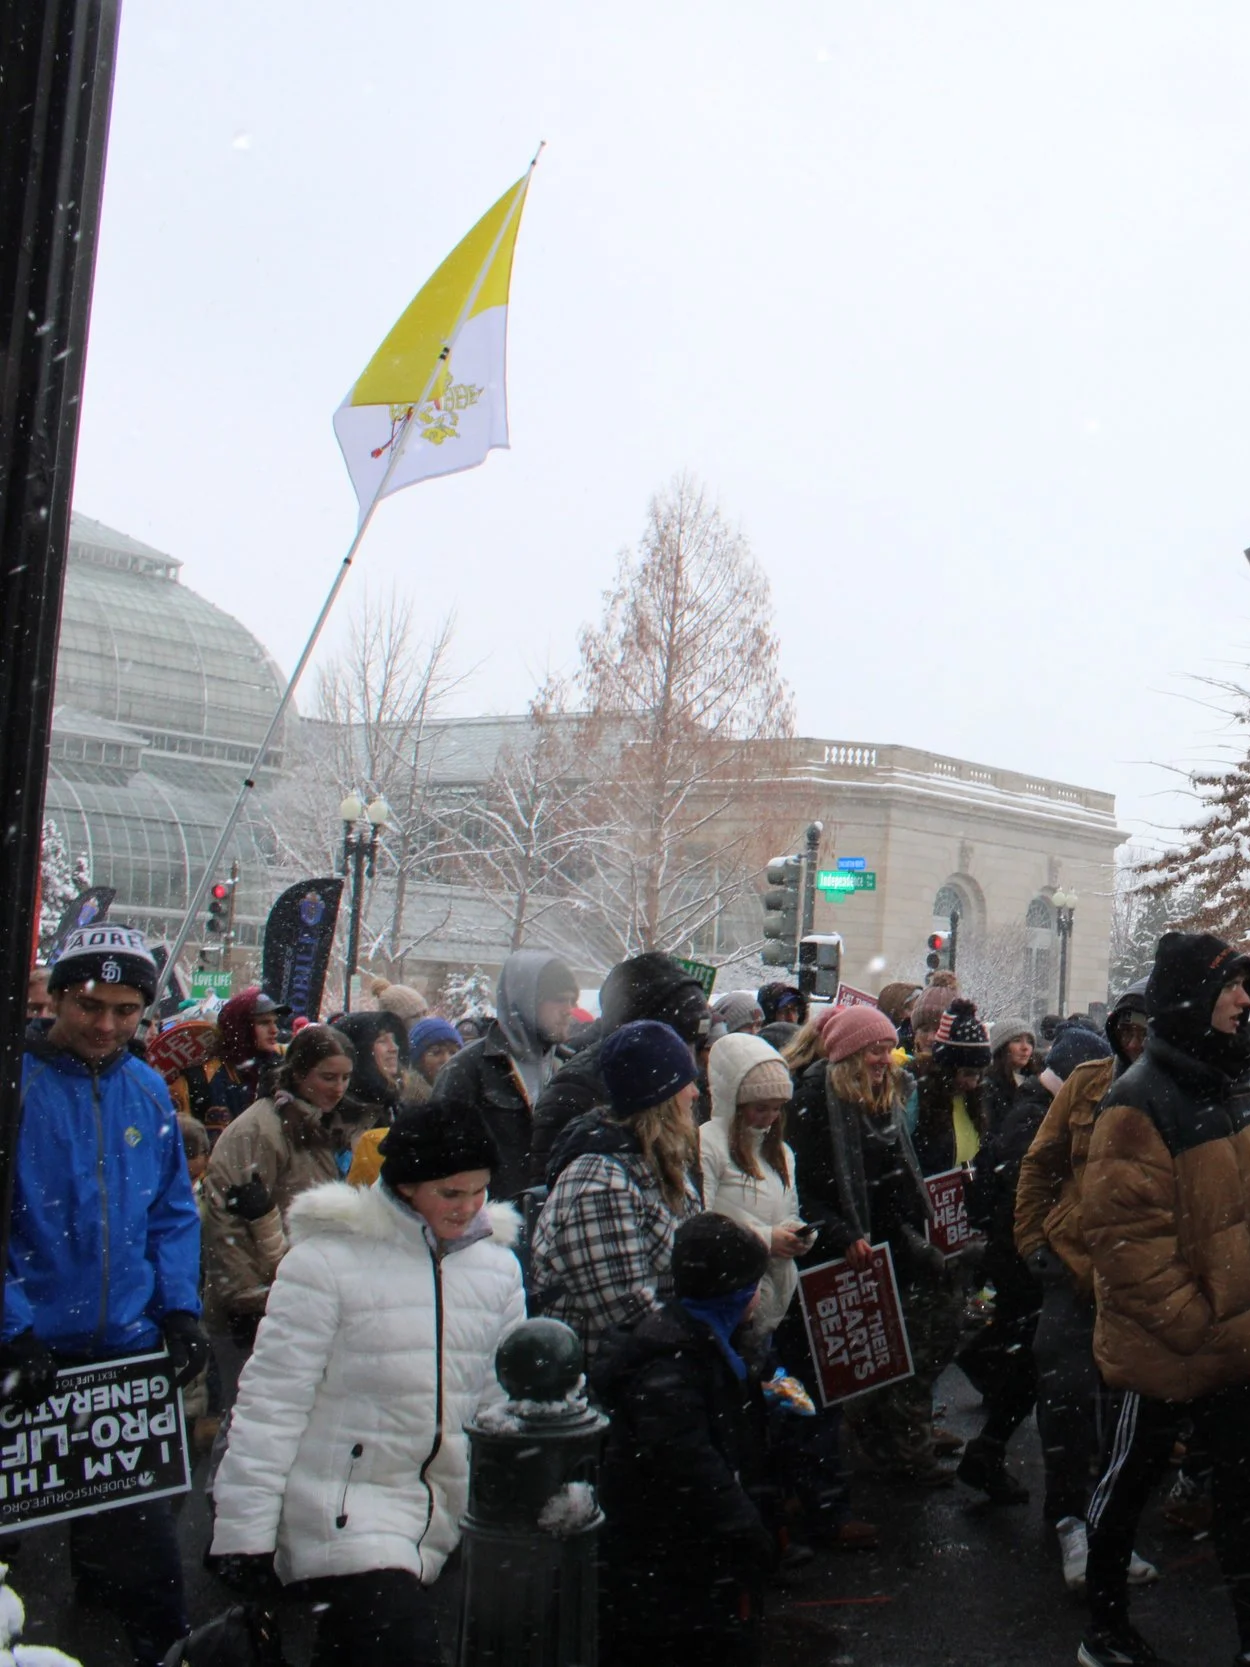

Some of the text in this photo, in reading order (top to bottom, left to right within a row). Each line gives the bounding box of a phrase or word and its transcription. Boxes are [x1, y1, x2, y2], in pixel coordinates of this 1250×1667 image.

[819, 872, 864, 890] Independence
[69, 931, 145, 951] ADRE
[193, 973, 230, 986] LOVE LIFE
[934, 1187, 957, 1208] LET
[933, 1201, 968, 1230] HEA
[834, 1270, 876, 1381] HEARTS
[858, 1268, 891, 1368] LET THEIR
[815, 1296, 850, 1368] BEAT
[61, 1380, 74, 1389] TO
[76, 1374, 96, 1385] LIFE
[97, 1370, 118, 1380] TEXT
[0, 1375, 170, 1430] GENERATIO
[1, 1403, 177, 1469] PRO-LIF
[84, 1446, 143, 1481] AM
[160, 1441, 170, 1464] I
[3, 1475, 137, 1515] STUDENTSFORLIFE.ORG
